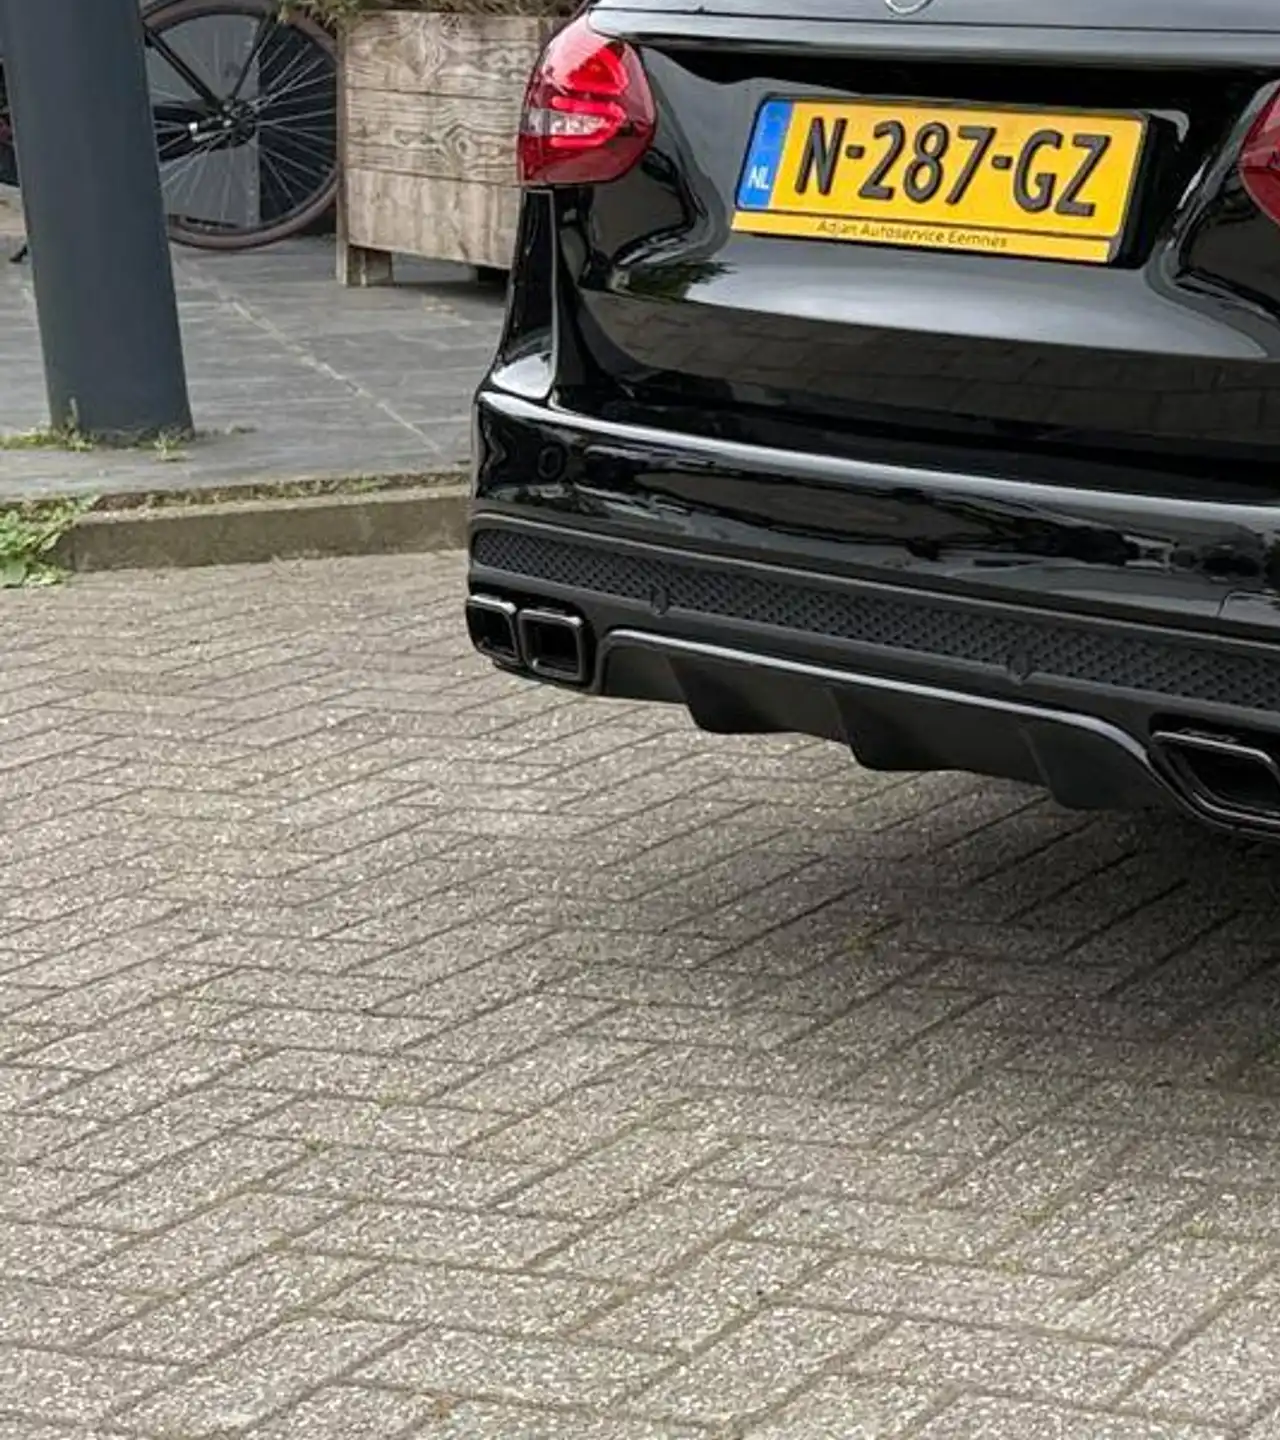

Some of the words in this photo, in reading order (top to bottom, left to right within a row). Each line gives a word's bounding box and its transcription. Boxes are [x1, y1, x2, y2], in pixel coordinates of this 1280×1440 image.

[747, 165, 769, 189] NL
[794, 115, 1112, 217] N-287-GZ
[861, 222, 945, 243] Autoservice
[948, 230, 1009, 249] Eemnes
